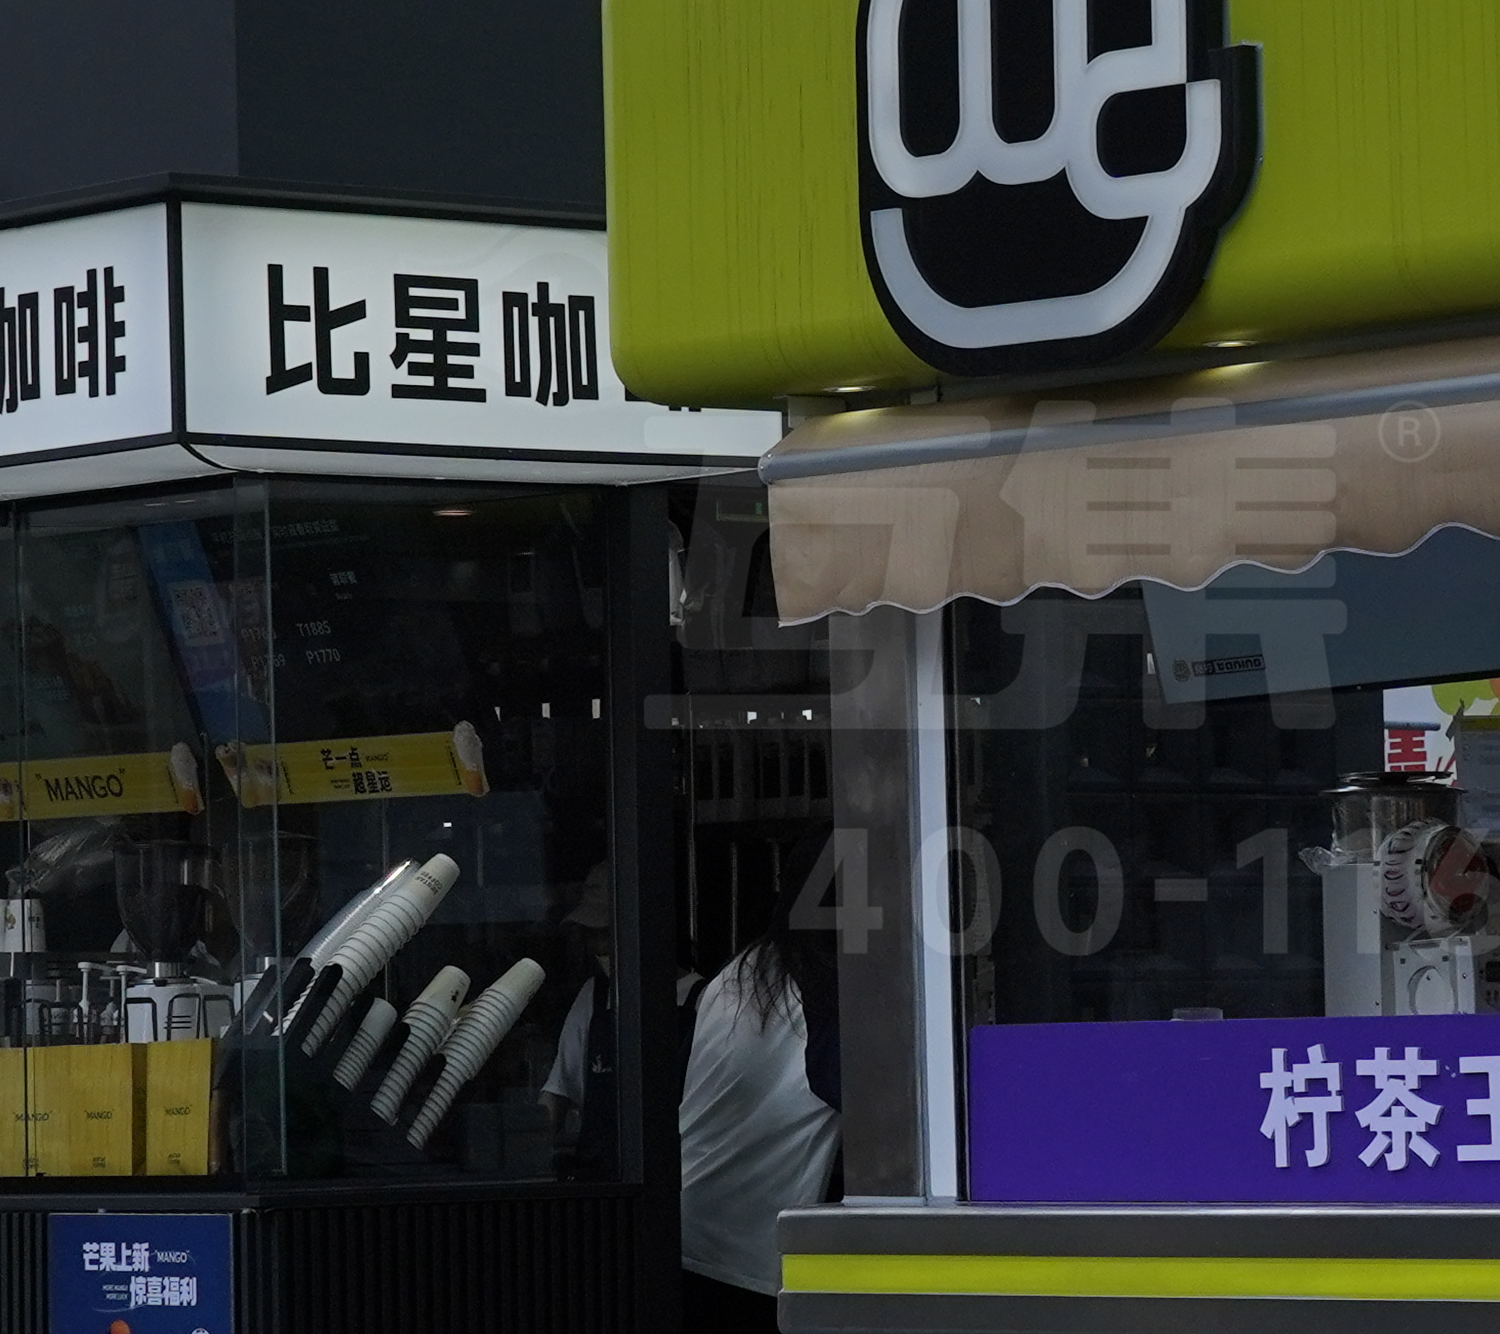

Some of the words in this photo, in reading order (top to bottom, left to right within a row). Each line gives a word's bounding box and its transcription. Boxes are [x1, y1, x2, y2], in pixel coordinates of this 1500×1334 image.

[266, 264, 701, 411] 比星咖
[82, 1241, 150, 1273] 芒果上新
[130, 1275, 198, 1309] 惊喜福利
